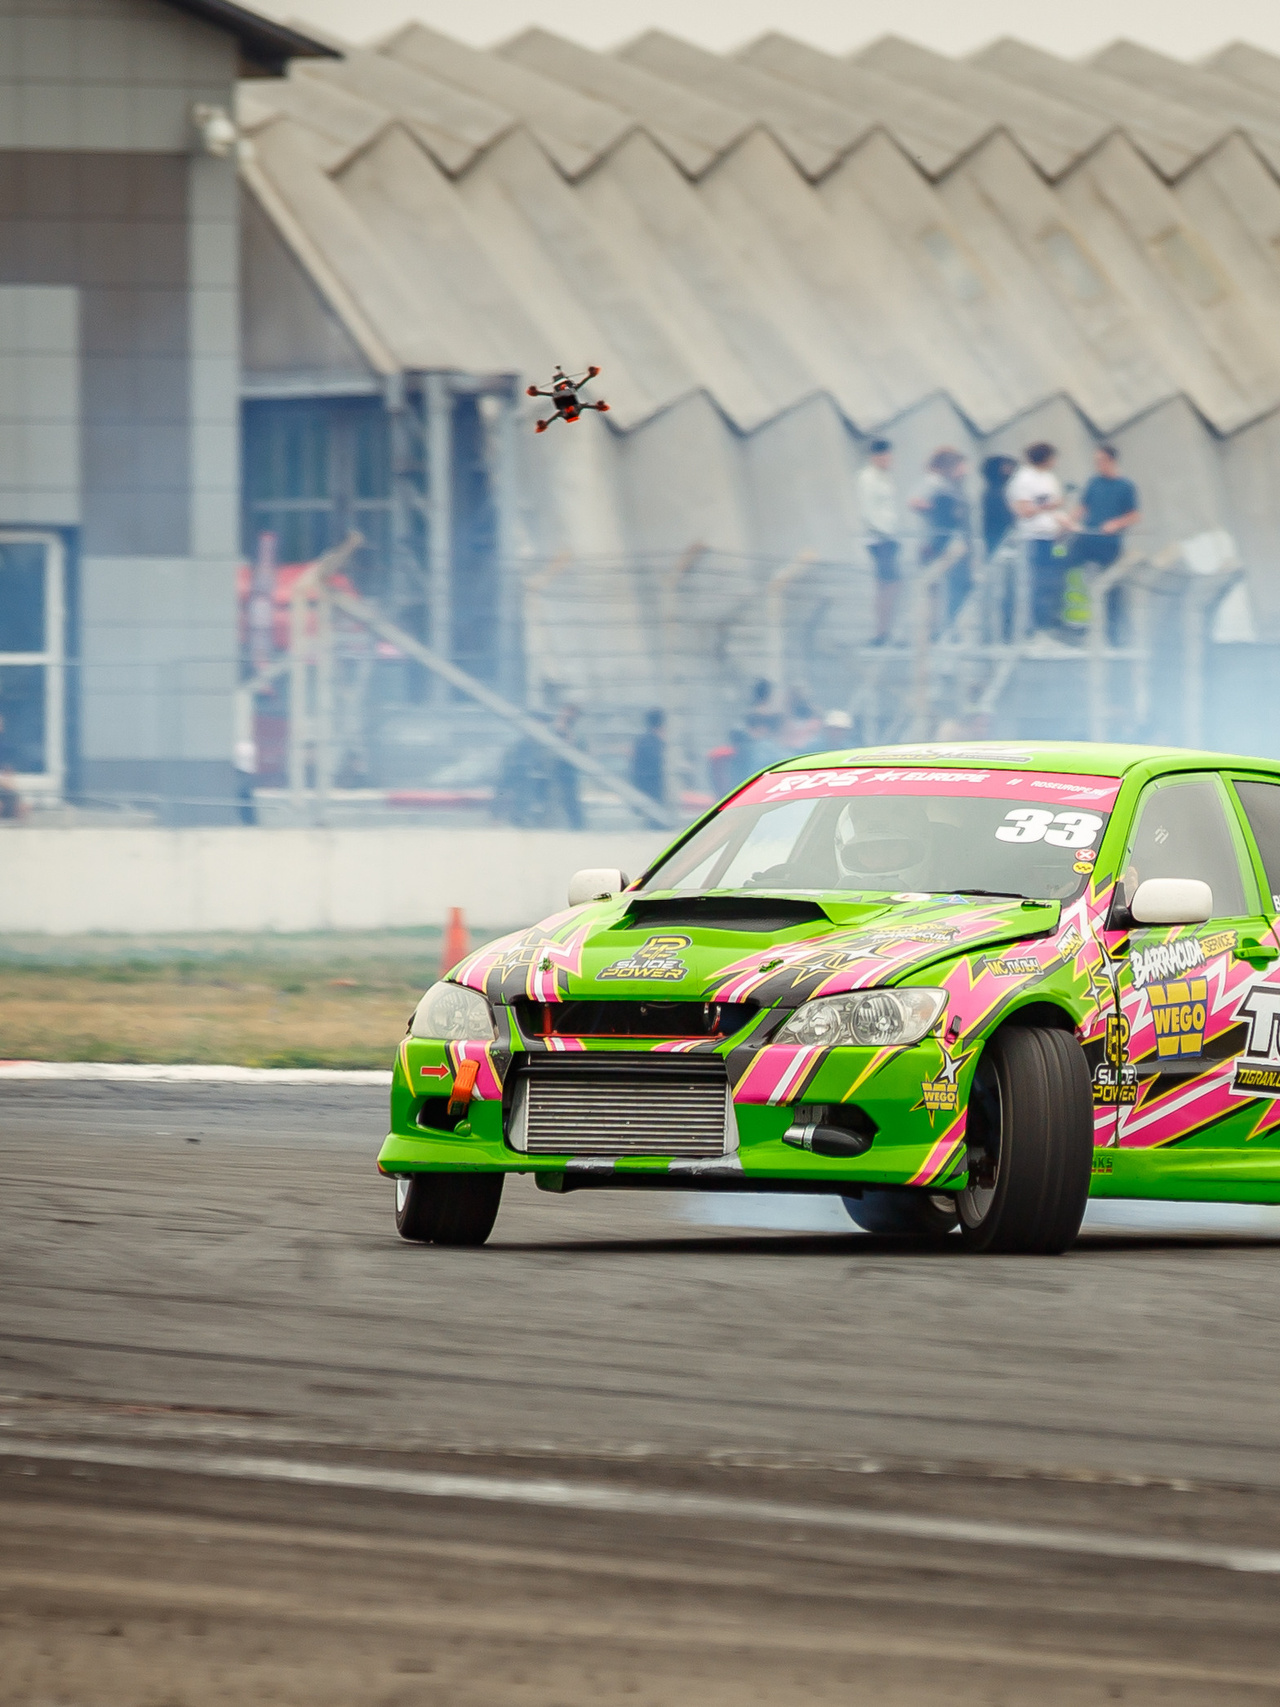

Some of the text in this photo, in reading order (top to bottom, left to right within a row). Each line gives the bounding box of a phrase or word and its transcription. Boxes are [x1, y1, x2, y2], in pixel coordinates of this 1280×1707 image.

[765, 769, 868, 794] RDS
[901, 771, 990, 784] EUROPE
[995, 808, 1103, 849] 33
[615, 960, 679, 969] SLIDE
[1129, 937, 1206, 991] BARRACUDA
[1203, 934, 1233, 953] SERVICE
[600, 968, 684, 979] POWER
[1153, 1003, 1206, 1035] WEGO
[1098, 1069, 1134, 1086] SLIDE
[924, 1091, 956, 1103] WEGO
[1092, 1085, 1137, 1102] POWER
